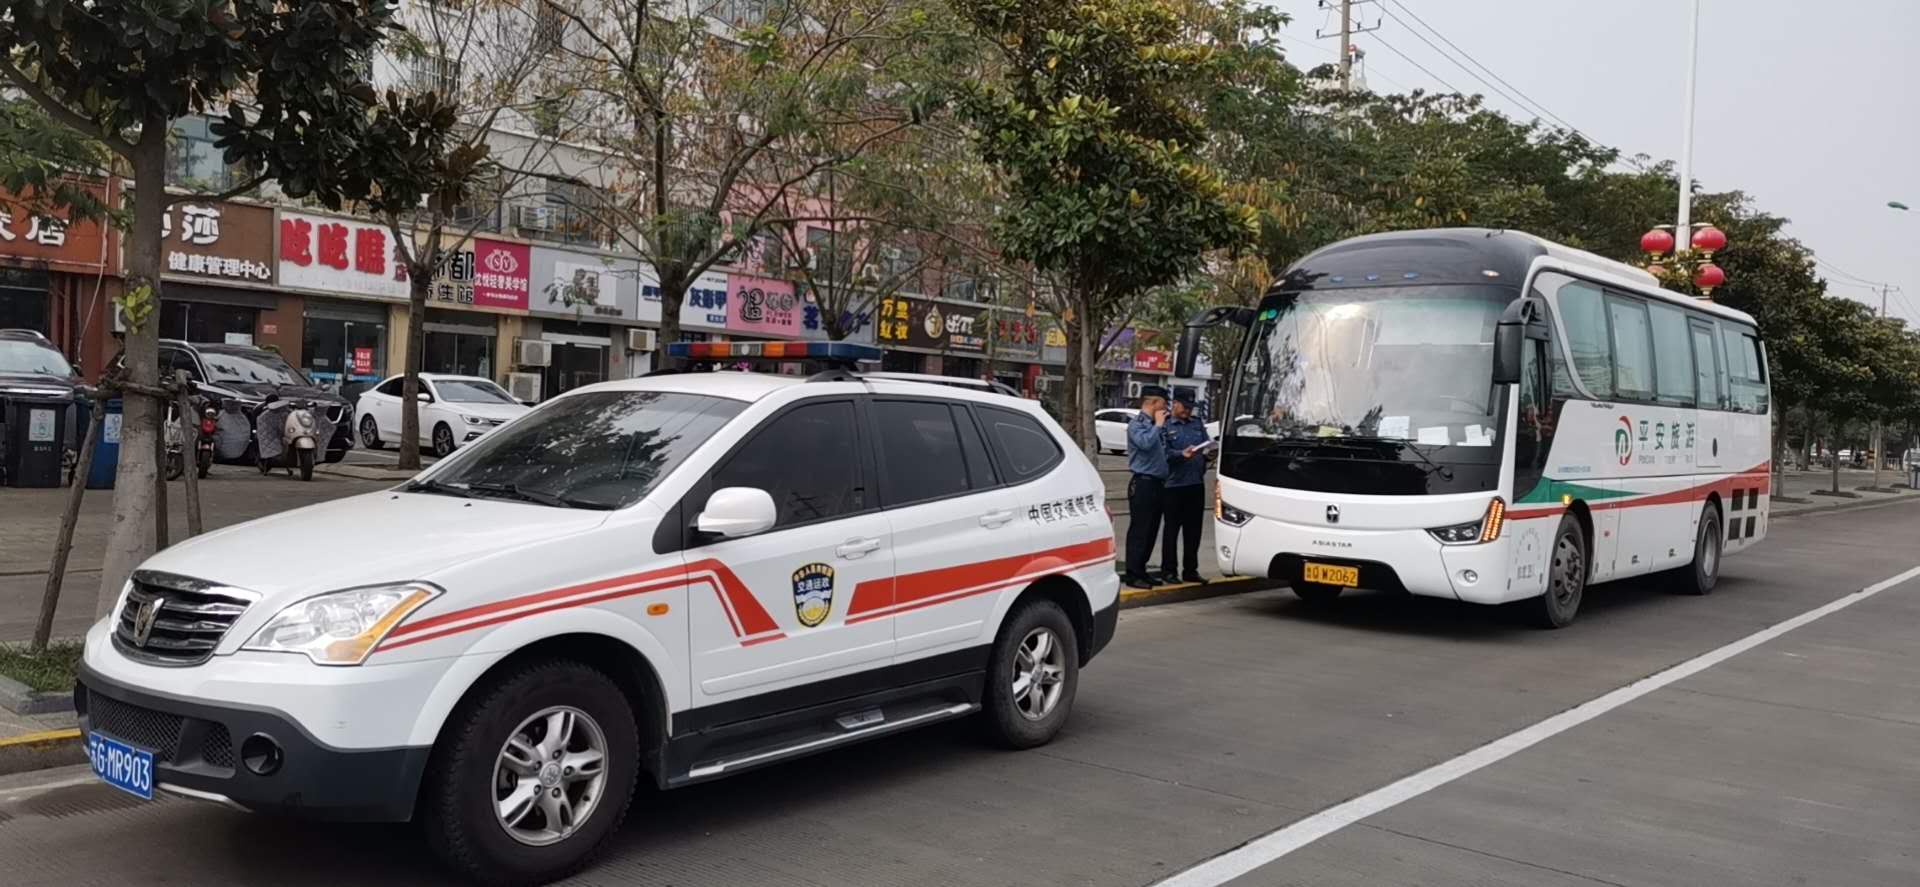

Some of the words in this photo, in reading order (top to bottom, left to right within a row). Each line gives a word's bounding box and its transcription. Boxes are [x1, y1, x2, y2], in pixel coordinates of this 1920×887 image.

[168, 251, 272, 280] 健康管理中心
[1638, 420, 1695, 450] 平安旅游
